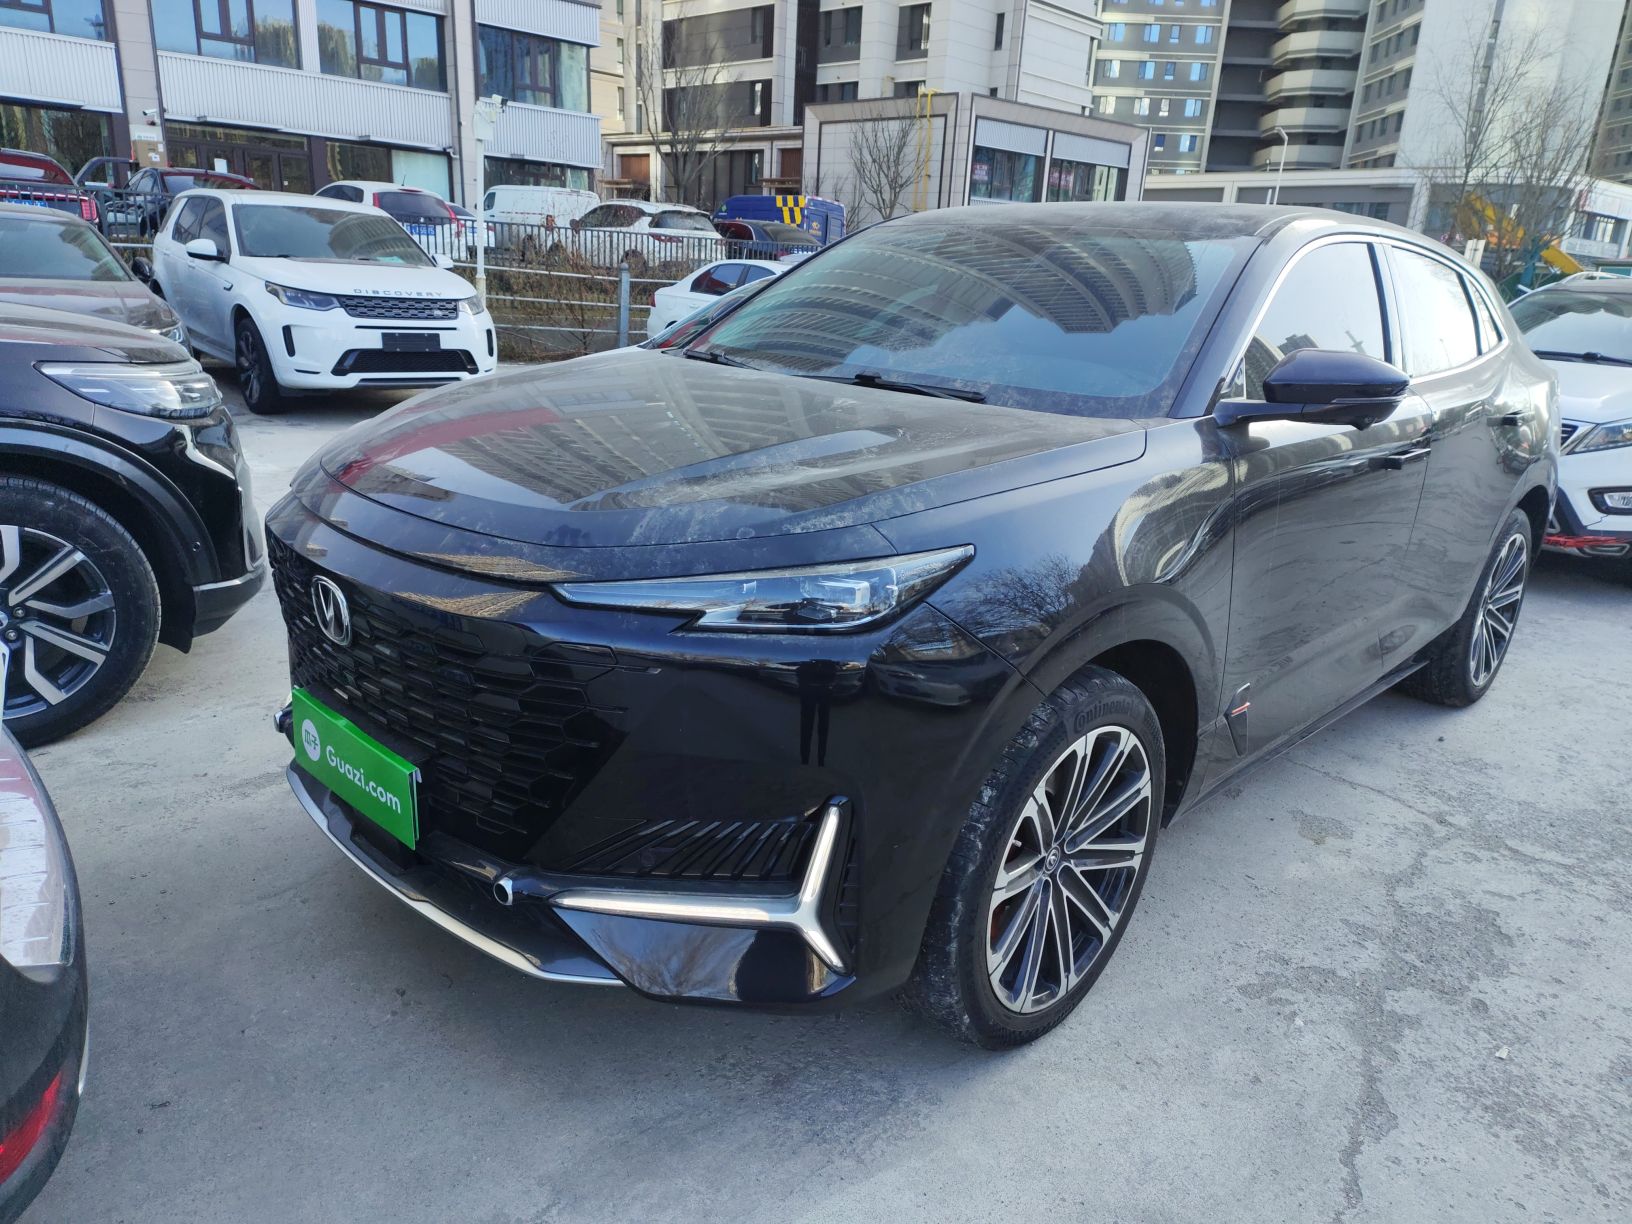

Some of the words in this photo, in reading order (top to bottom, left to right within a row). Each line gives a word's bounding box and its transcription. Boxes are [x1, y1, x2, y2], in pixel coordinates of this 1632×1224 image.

[353, 288, 443, 297] DISCOVERY
[304, 729, 319, 750] 瓜子
[326, 745, 401, 815] Guazi.com
